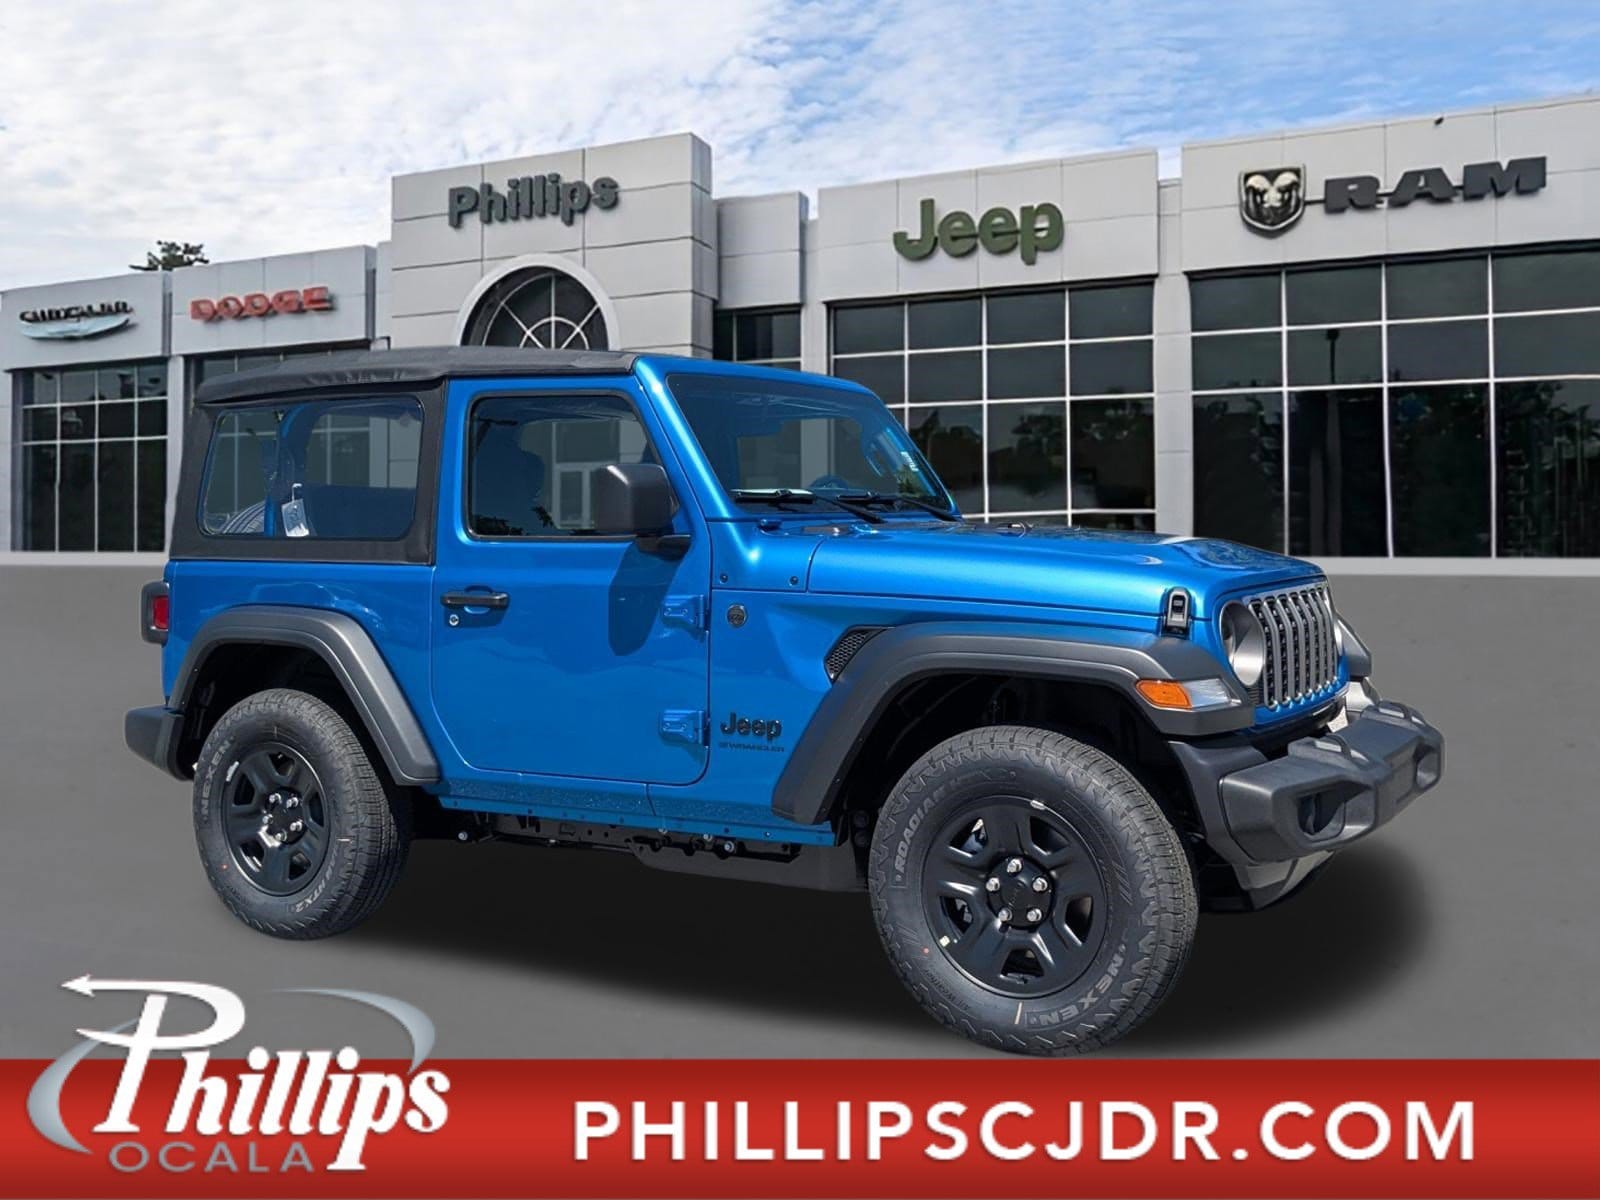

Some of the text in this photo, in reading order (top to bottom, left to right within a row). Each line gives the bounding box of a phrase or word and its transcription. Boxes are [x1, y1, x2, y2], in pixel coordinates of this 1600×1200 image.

[448, 173, 621, 229] Phillips
[1324, 156, 1547, 214] RAM
[893, 198, 1065, 266] Jeep
[190, 286, 335, 323] DODGE
[720, 711, 783, 742] Jeep
[1039, 953, 1124, 1026] NEXEN
